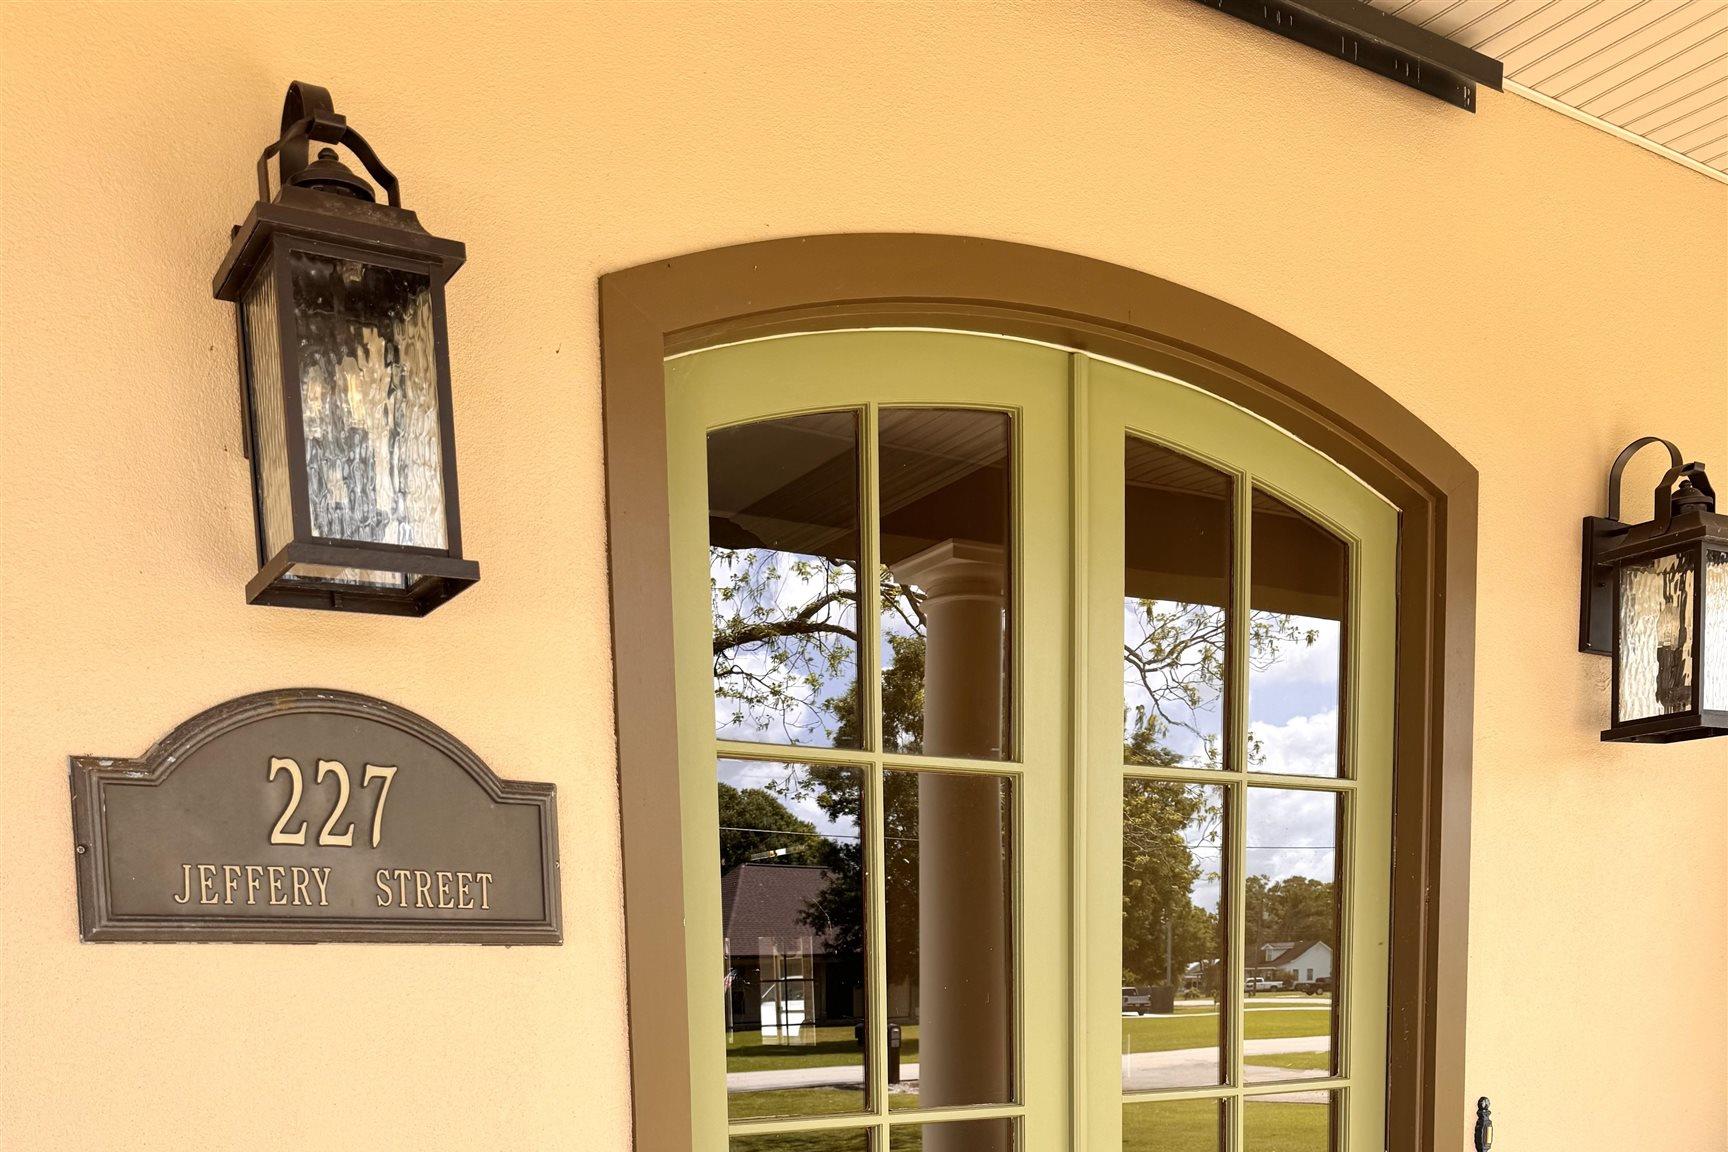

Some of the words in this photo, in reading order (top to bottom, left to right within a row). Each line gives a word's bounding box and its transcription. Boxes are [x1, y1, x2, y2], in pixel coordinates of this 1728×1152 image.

[268, 757, 398, 848] 227
[173, 864, 331, 906] JEFFERY
[375, 869, 493, 910] STREET
